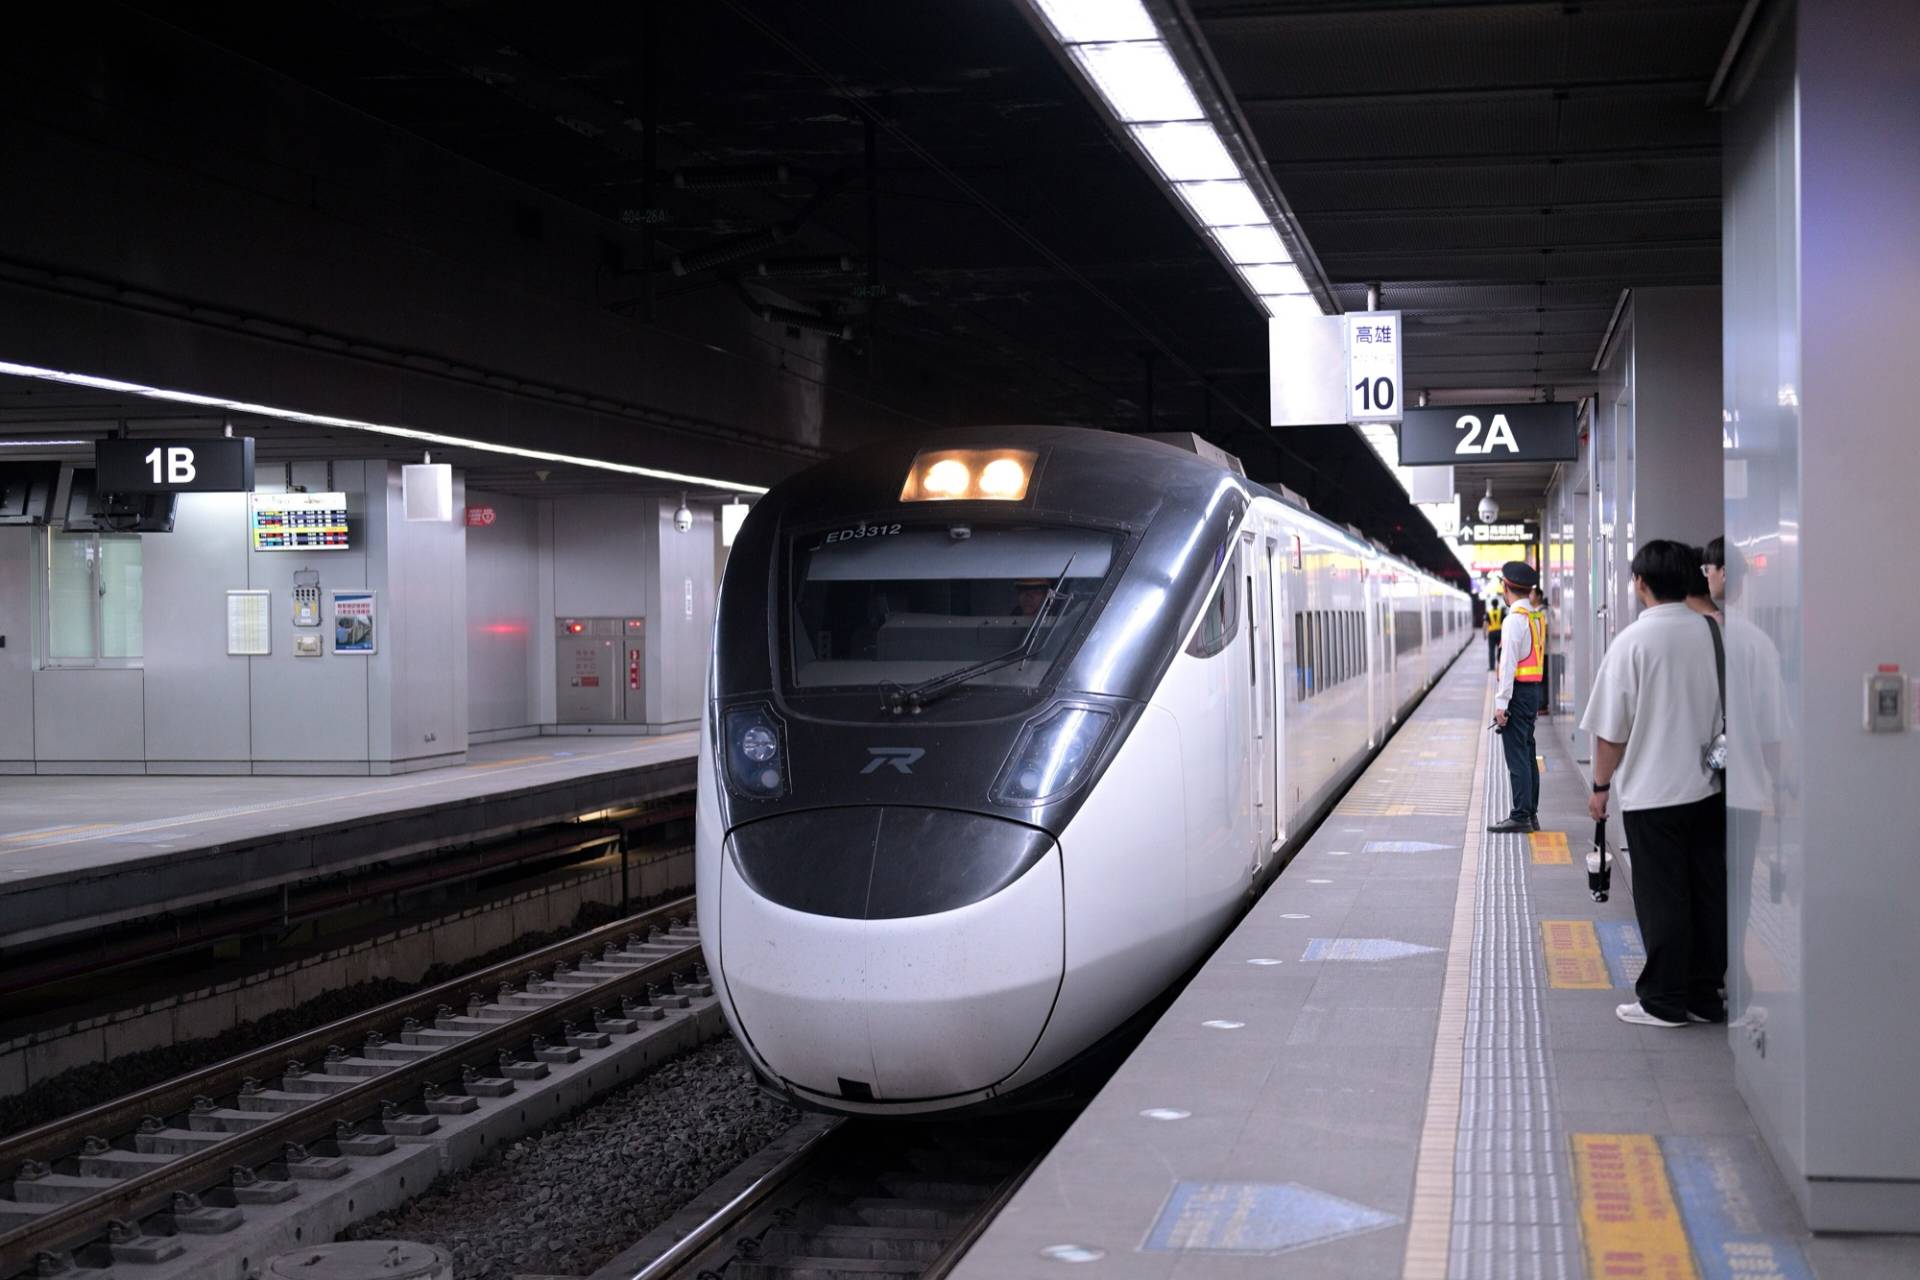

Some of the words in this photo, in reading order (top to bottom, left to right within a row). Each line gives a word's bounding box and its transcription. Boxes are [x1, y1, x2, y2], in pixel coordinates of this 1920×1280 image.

[1356, 325, 1392, 344] 高雄
[1355, 377, 1394, 410] 10
[1455, 414, 1520, 454] 2A
[145, 447, 196, 483] 1B
[826, 523, 902, 543] ED3312
